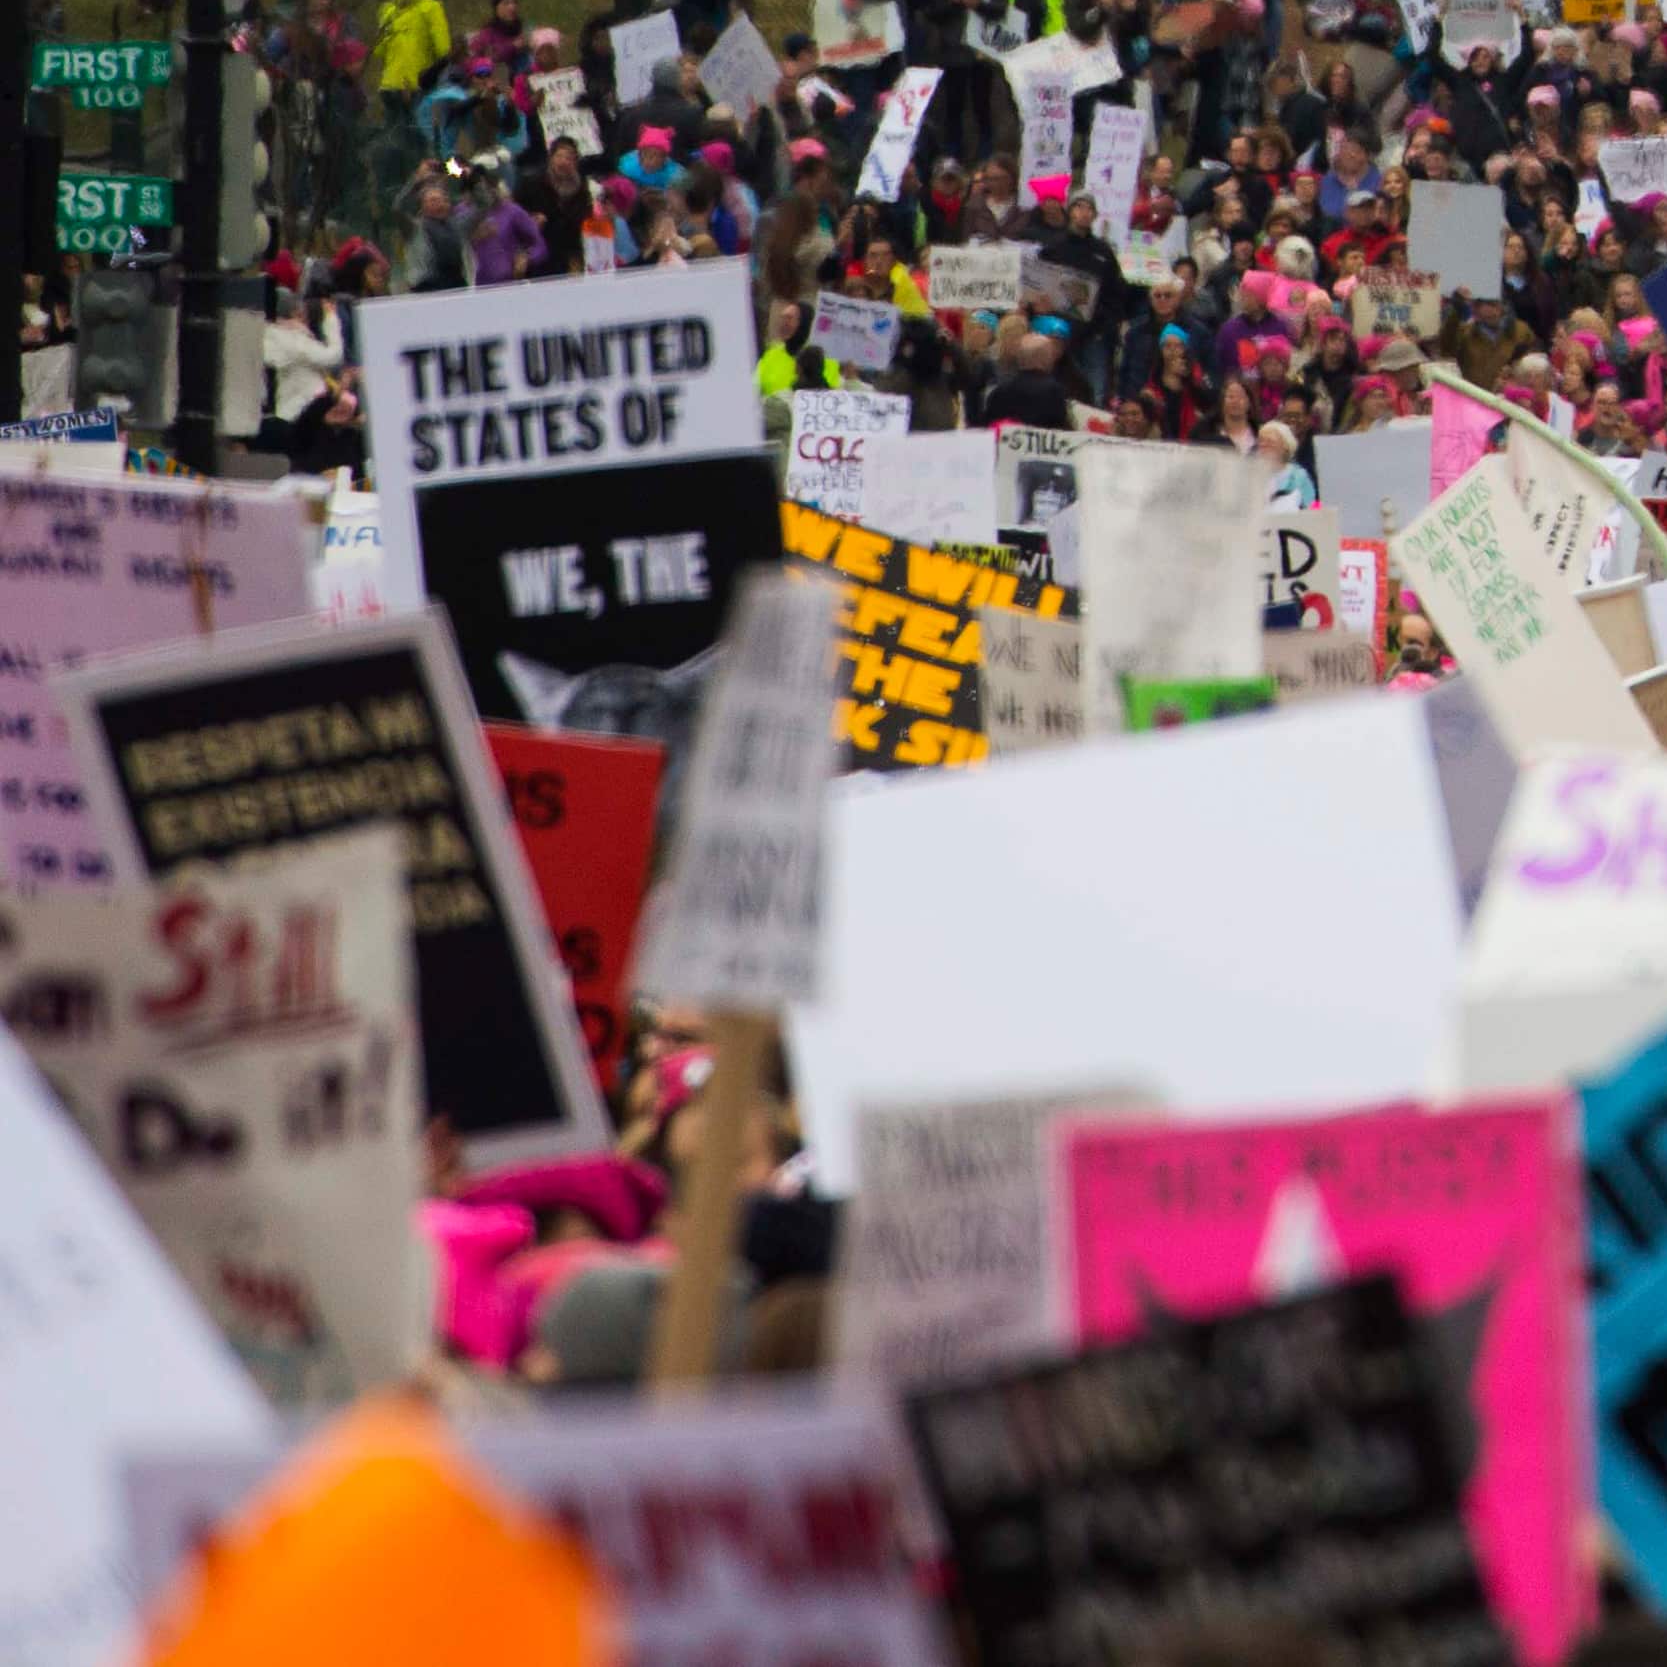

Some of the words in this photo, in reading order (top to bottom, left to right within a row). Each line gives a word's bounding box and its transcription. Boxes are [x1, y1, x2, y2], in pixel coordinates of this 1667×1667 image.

[42, 48, 143, 81] FIRST
[79, 85, 141, 107] 100
[401, 343, 508, 402] THE
[526, 316, 715, 391] UNITED
[37, 409, 111, 436] WOMEN
[410, 398, 604, 474] STATES
[617, 386, 686, 447] OF
[1438, 475, 1492, 534] RIGHTS
[1456, 509, 1500, 550] NOT
[779, 499, 894, 584] WE
[500, 547, 603, 618] WE,
[613, 532, 710, 604] THE
